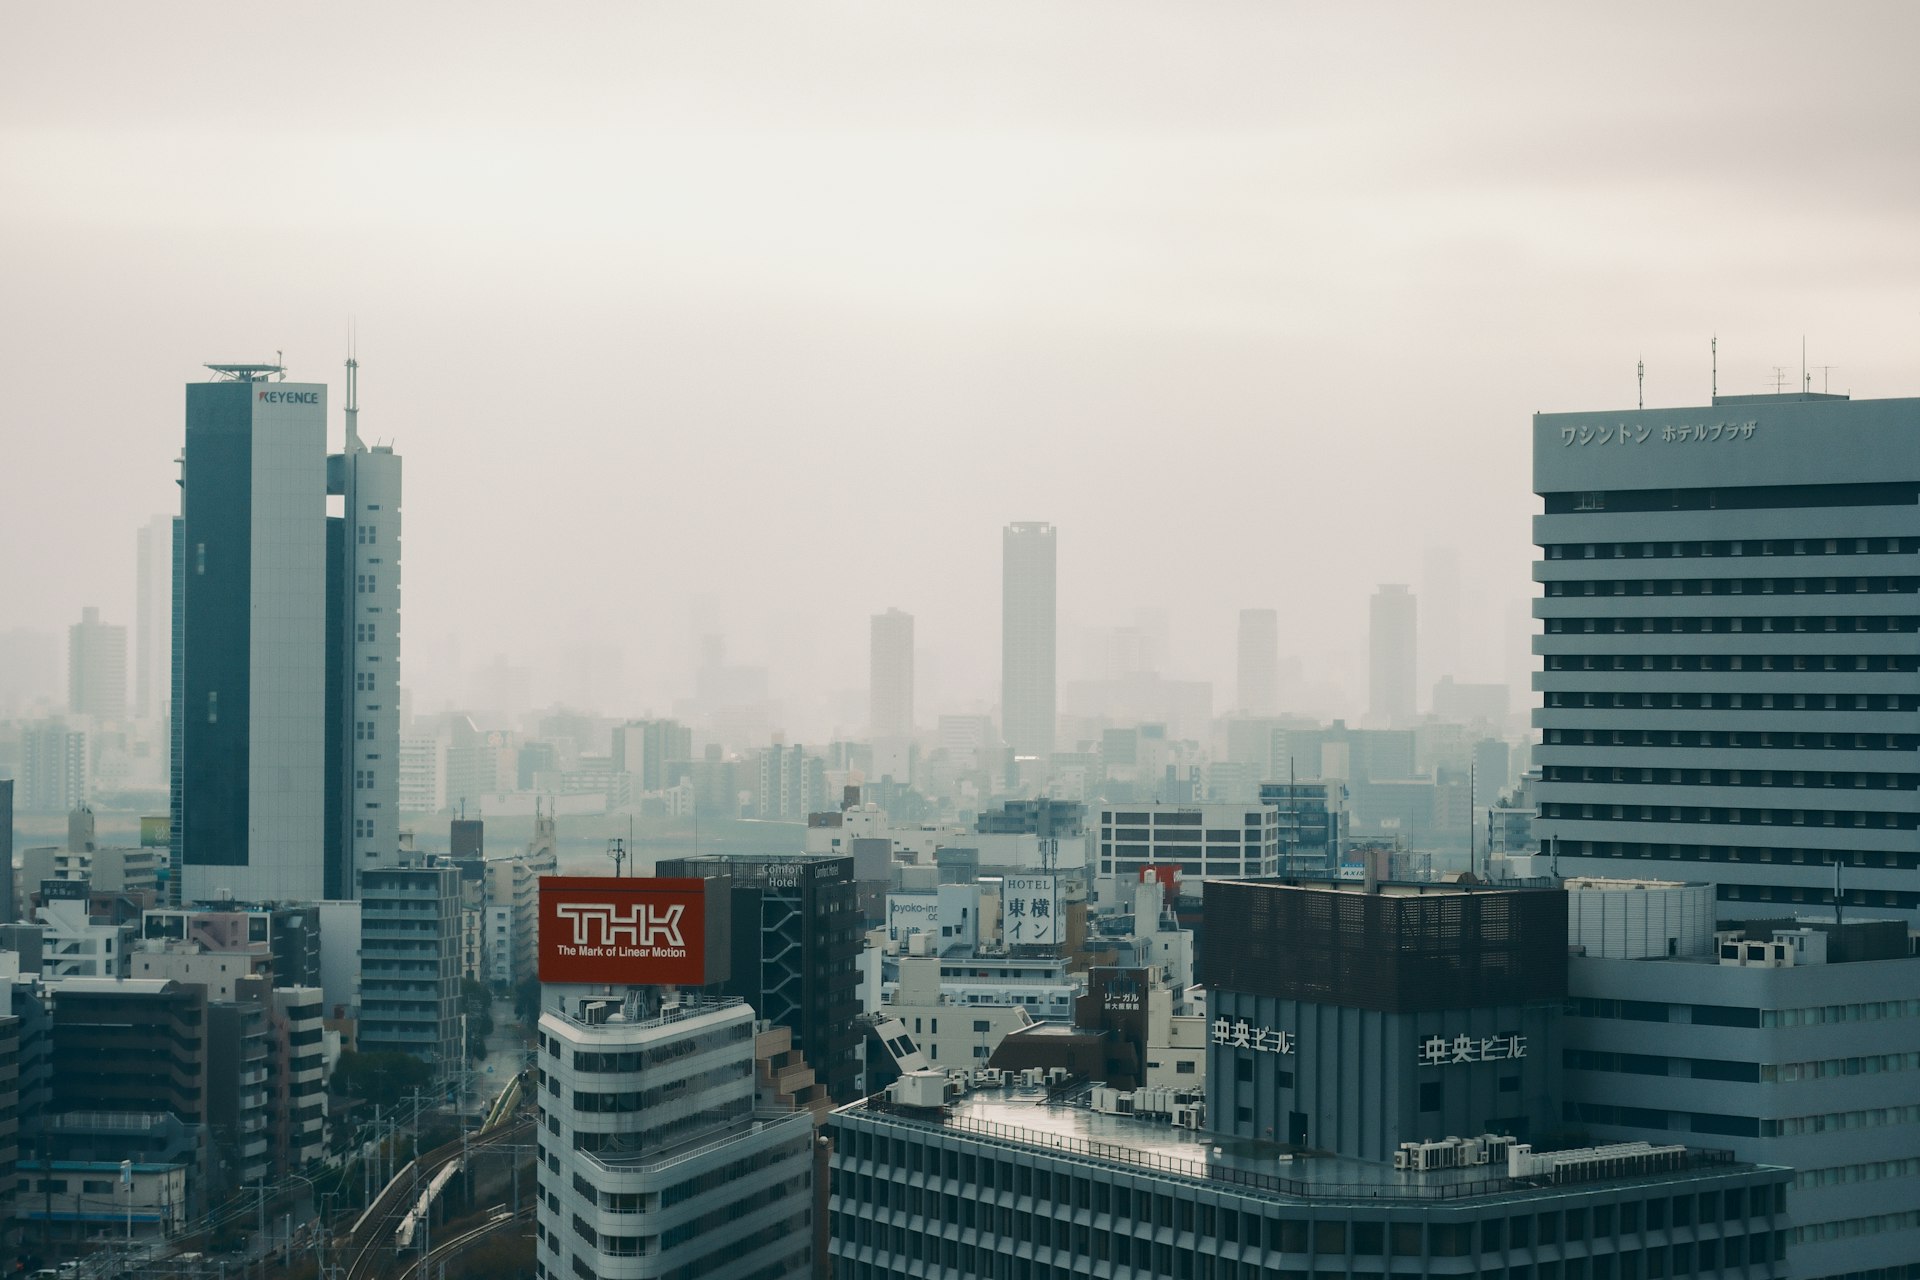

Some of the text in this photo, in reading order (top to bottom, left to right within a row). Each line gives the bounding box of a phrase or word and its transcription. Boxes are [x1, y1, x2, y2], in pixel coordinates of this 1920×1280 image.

[258, 391, 318, 404] KEYENCE
[1561, 420, 1757, 446] ワシントン ホテルプラザ
[762, 864, 804, 875] Comfort
[769, 877, 797, 887] Hotel
[1008, 880, 1050, 890] HOTEL
[557, 902, 685, 946] THK
[558, 945, 686, 958] The Mark of Linear Motion
[1104, 993, 1139, 1002] リーガル
[1215, 1016, 1290, 1055] 中央ビル
[1426, 1033, 1524, 1066] 中央ビル
